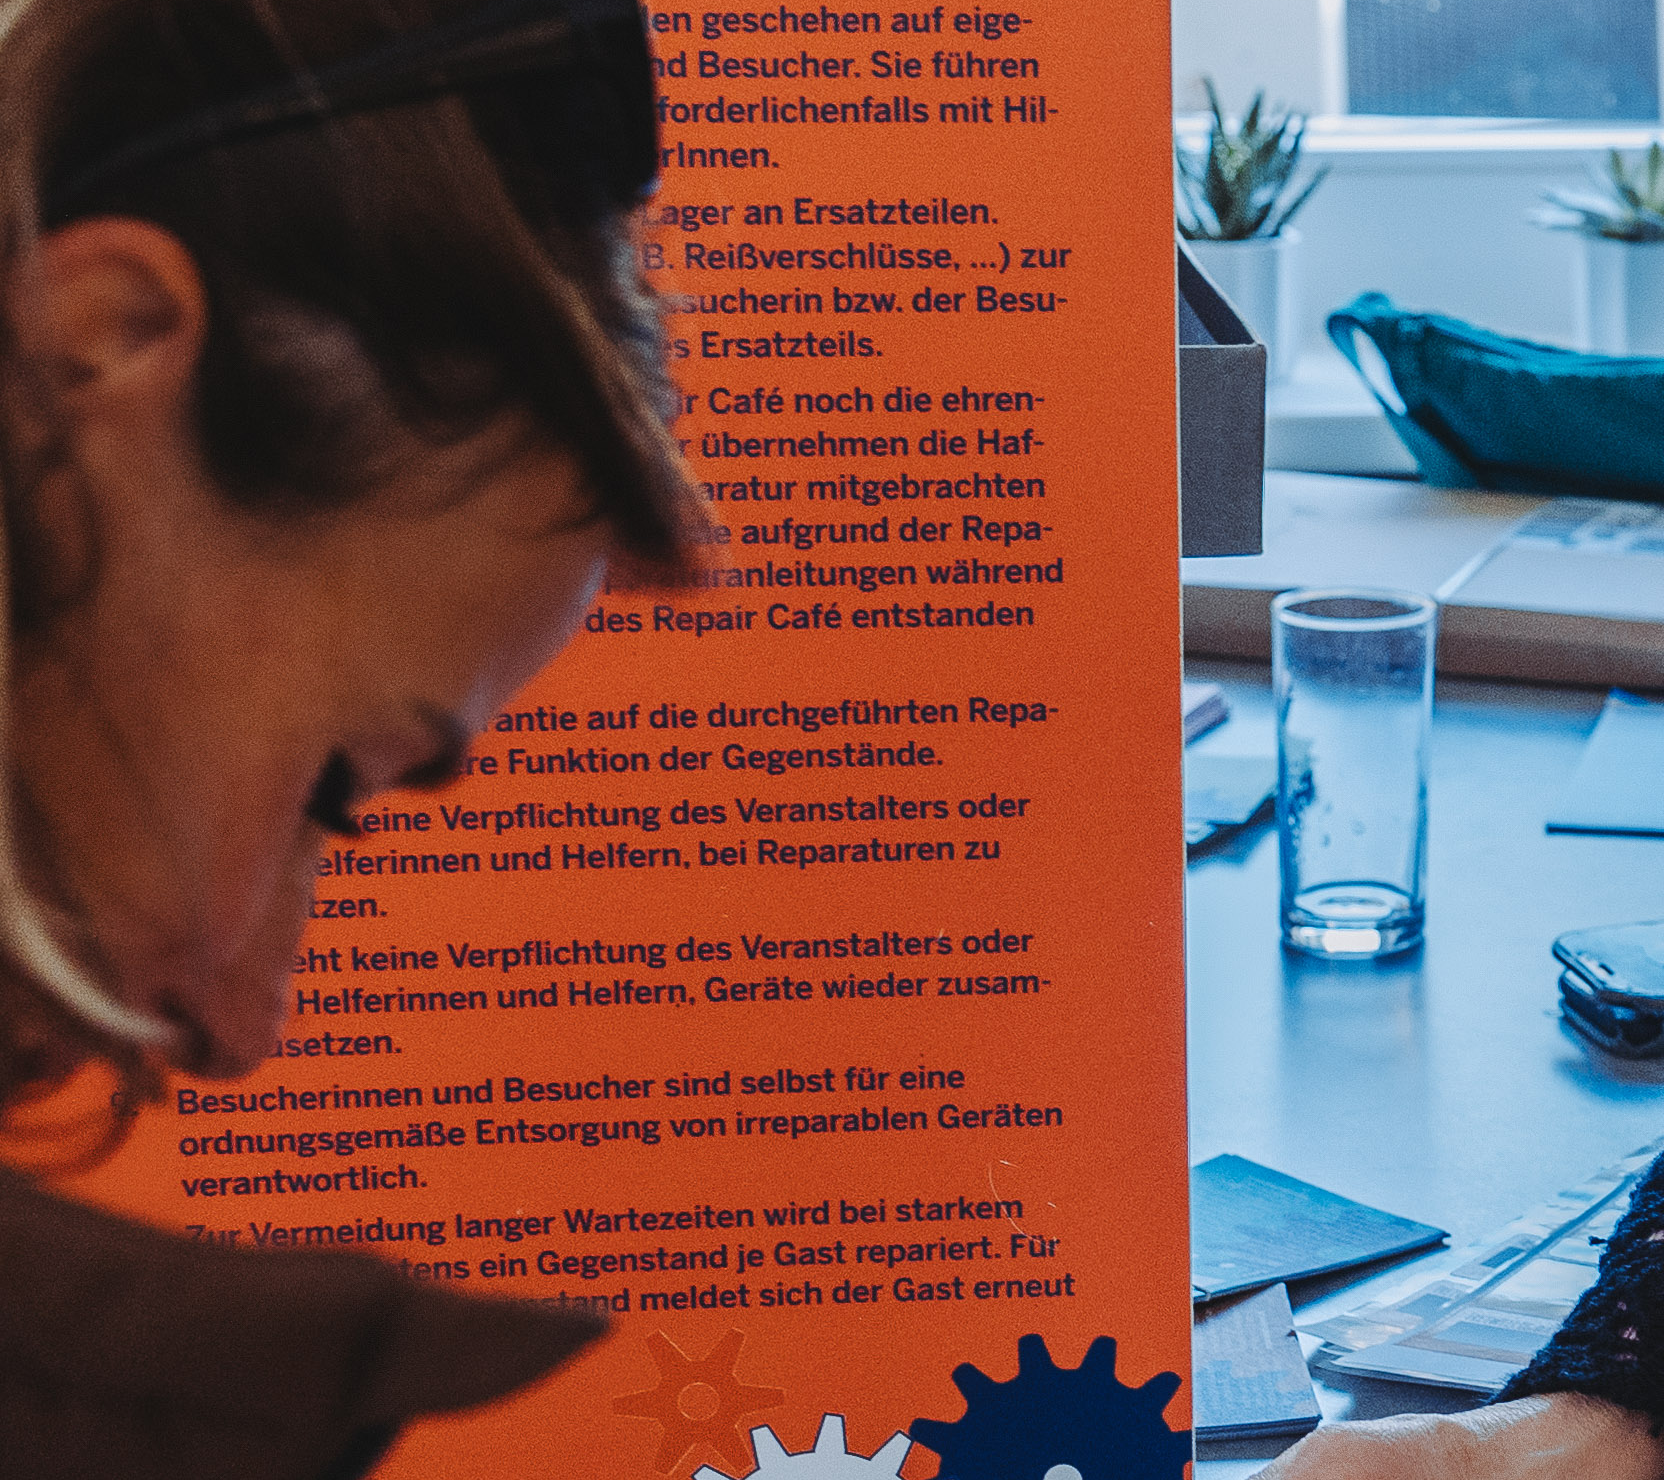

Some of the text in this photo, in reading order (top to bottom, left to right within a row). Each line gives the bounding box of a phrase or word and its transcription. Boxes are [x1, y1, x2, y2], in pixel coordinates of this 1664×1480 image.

[702, 5, 881, 41] geschehen
[890, 5, 944, 34] auf
[953, 12, 1032, 41] eige-
[653, 50, 1039, 79] nd Besucher. Sie führen
[657, 95, 1058, 124] forderlichenfalls mit Hil-
[661, 141, 781, 168] rInnen.
[743, 204, 783, 226] an
[794, 197, 998, 226] Ersatzteilen.
[685, 242, 960, 271] Reißverschlüsse,
[1020, 248, 1072, 269] zur
[680, 285, 1067, 314] sucherin bzw. der Besu-
[701, 330, 883, 359] Ersatzteils.
[708, 386, 784, 415] Café
[794, 386, 874, 414] noch
[883, 386, 932, 413] die
[941, 385, 1044, 413] ehren-
[701, 430, 909, 459] übernehmen
[918, 429, 967, 457] die
[977, 428, 1044, 456] Haf-
[701, 472, 1046, 507] aratur mitgebrachten
[741, 516, 889, 551] aufgrund
[898, 516, 952, 543] der
[962, 514, 1052, 548] Repa-
[926, 557, 1064, 585] während
[585, 600, 1034, 638] des Repair Café entstanden
[497, 696, 1058, 733] antie auf die durchgeführten Repa-
[508, 747, 650, 775] Funktion
[658, 745, 713, 772] der
[722, 740, 943, 776] Gegenstände.
[439, 801, 661, 836] Verpflichtung
[669, 799, 727, 825] des
[735, 794, 949, 824] Veranstalters
[957, 792, 1030, 819] oder
[317, 837, 1001, 878] elferinnen und Helfern, bei Reparaturen zu
[351, 946, 439, 972] keine
[447, 939, 667, 973] Verpflichtung
[675, 936, 733, 962] des
[740, 931, 953, 960] Veranstalters
[961, 928, 1034, 955] oder
[296, 972, 1050, 1015] Helferinnen und Helfern, Geräte wieder zusam-
[266, 1031, 403, 1059] usetzen.
[177, 1065, 965, 1116] Besucherinnen und Besucher sind selbst für eine
[179, 1103, 1063, 1158] ordnungsgemäße Entsorgung von irreparablen Geräten
[181, 1163, 427, 1197] verantwortlich.
[250, 1215, 446, 1248] Vermeidung
[455, 1213, 555, 1243] langer
[563, 1205, 755, 1234] Wartezeiten
[763, 1200, 830, 1227] wird
[839, 1198, 886, 1225] bei
[895, 1196, 1024, 1223] starkem
[479, 1253, 528, 1279] ein
[536, 1244, 728, 1280] Gegenstand
[736, 1244, 765, 1274] je
[773, 1240, 846, 1267] Gast
[855, 1236, 1001, 1269] repariert.
[1010, 1233, 1060, 1258] Für
[639, 1283, 750, 1311] meldet
[759, 1281, 823, 1307] sich
[831, 1279, 883, 1304] der
[892, 1276, 964, 1303] Gast
[973, 1273, 1075, 1300] erneut
